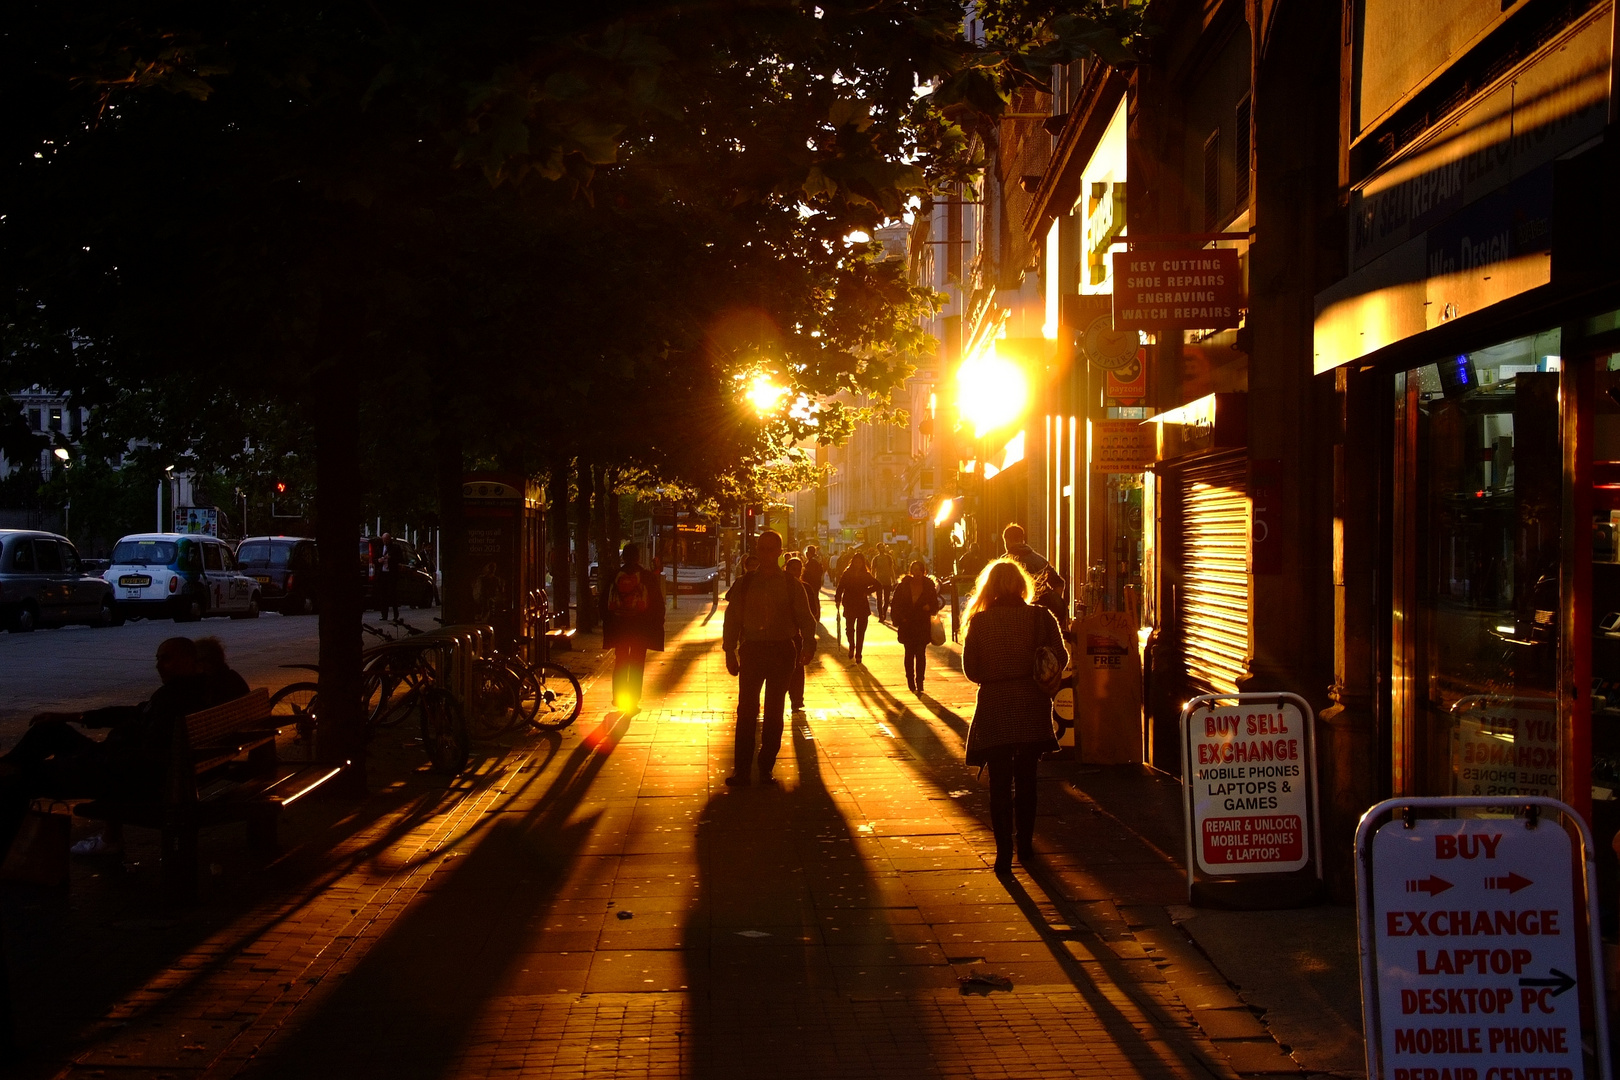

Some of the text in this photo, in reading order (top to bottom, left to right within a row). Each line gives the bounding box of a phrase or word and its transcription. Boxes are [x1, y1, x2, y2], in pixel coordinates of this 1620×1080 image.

[1354, 200, 1378, 254] BUY
[1379, 184, 1408, 239] SELL
[1411, 160, 1463, 220] REPAIR
[1130, 259, 1221, 272] KEY CUTTING
[1127, 275, 1225, 288] SHOE REPAIRS
[1137, 291, 1215, 303] ENGRAVING
[1121, 306, 1232, 320] WATCH REPAIRS
[1109, 386, 1143, 395] payzone
[494, 528, 502, 536] all
[695, 524, 707, 533] 216
[484, 544, 501, 552] 2012
[1093, 656, 1121, 665] FREE
[1204, 713, 1288, 737] BUY SELL
[1198, 739, 1298, 765] EXCHANGE
[1199, 765, 1300, 780] MOBILE PHONES
[1208, 780, 1291, 796] LAPTOPS &
[1224, 796, 1278, 811] GAMES
[1205, 818, 1298, 833] REPAIR & UNLOCK
[1210, 832, 1294, 847] MOBILE PHONES
[1435, 834, 1503, 860] BUY
[1226, 847, 1281, 861] & LAPTOPS
[1386, 910, 1560, 936] EXCHANGE
[1417, 949, 1532, 975] LAPTOP
[1401, 988, 1555, 1014] DESKTOP PC
[1395, 1027, 1569, 1054] MOBILE PHONE
